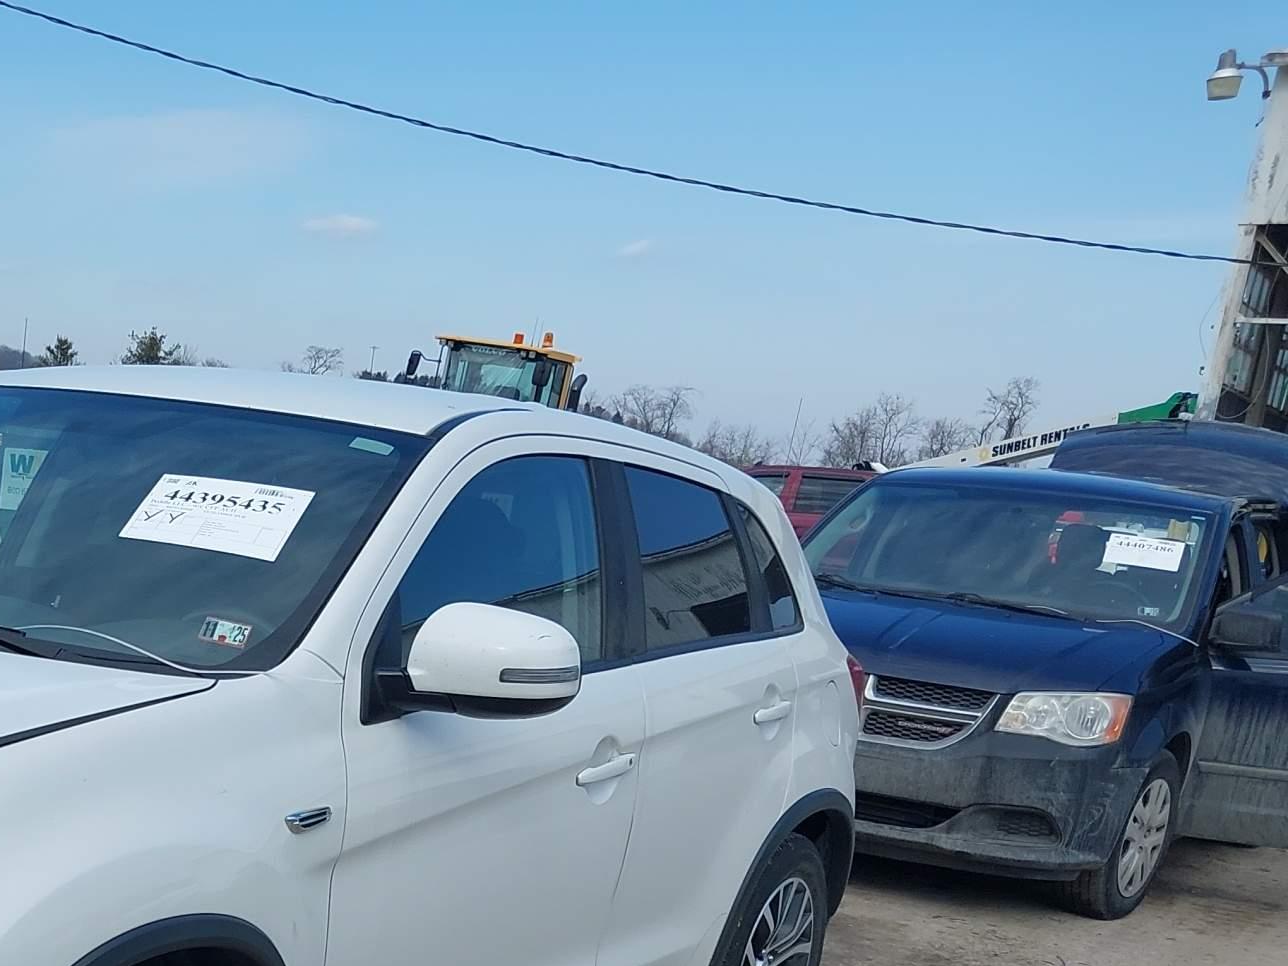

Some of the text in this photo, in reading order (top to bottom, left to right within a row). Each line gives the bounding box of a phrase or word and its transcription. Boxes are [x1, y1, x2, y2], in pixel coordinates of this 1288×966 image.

[991, 423, 1090, 458] SUNBELT RENT
[164, 488, 286, 516] 44395435
[1116, 540, 1174, 553] 44407486
[203, 620, 219, 638] 11
